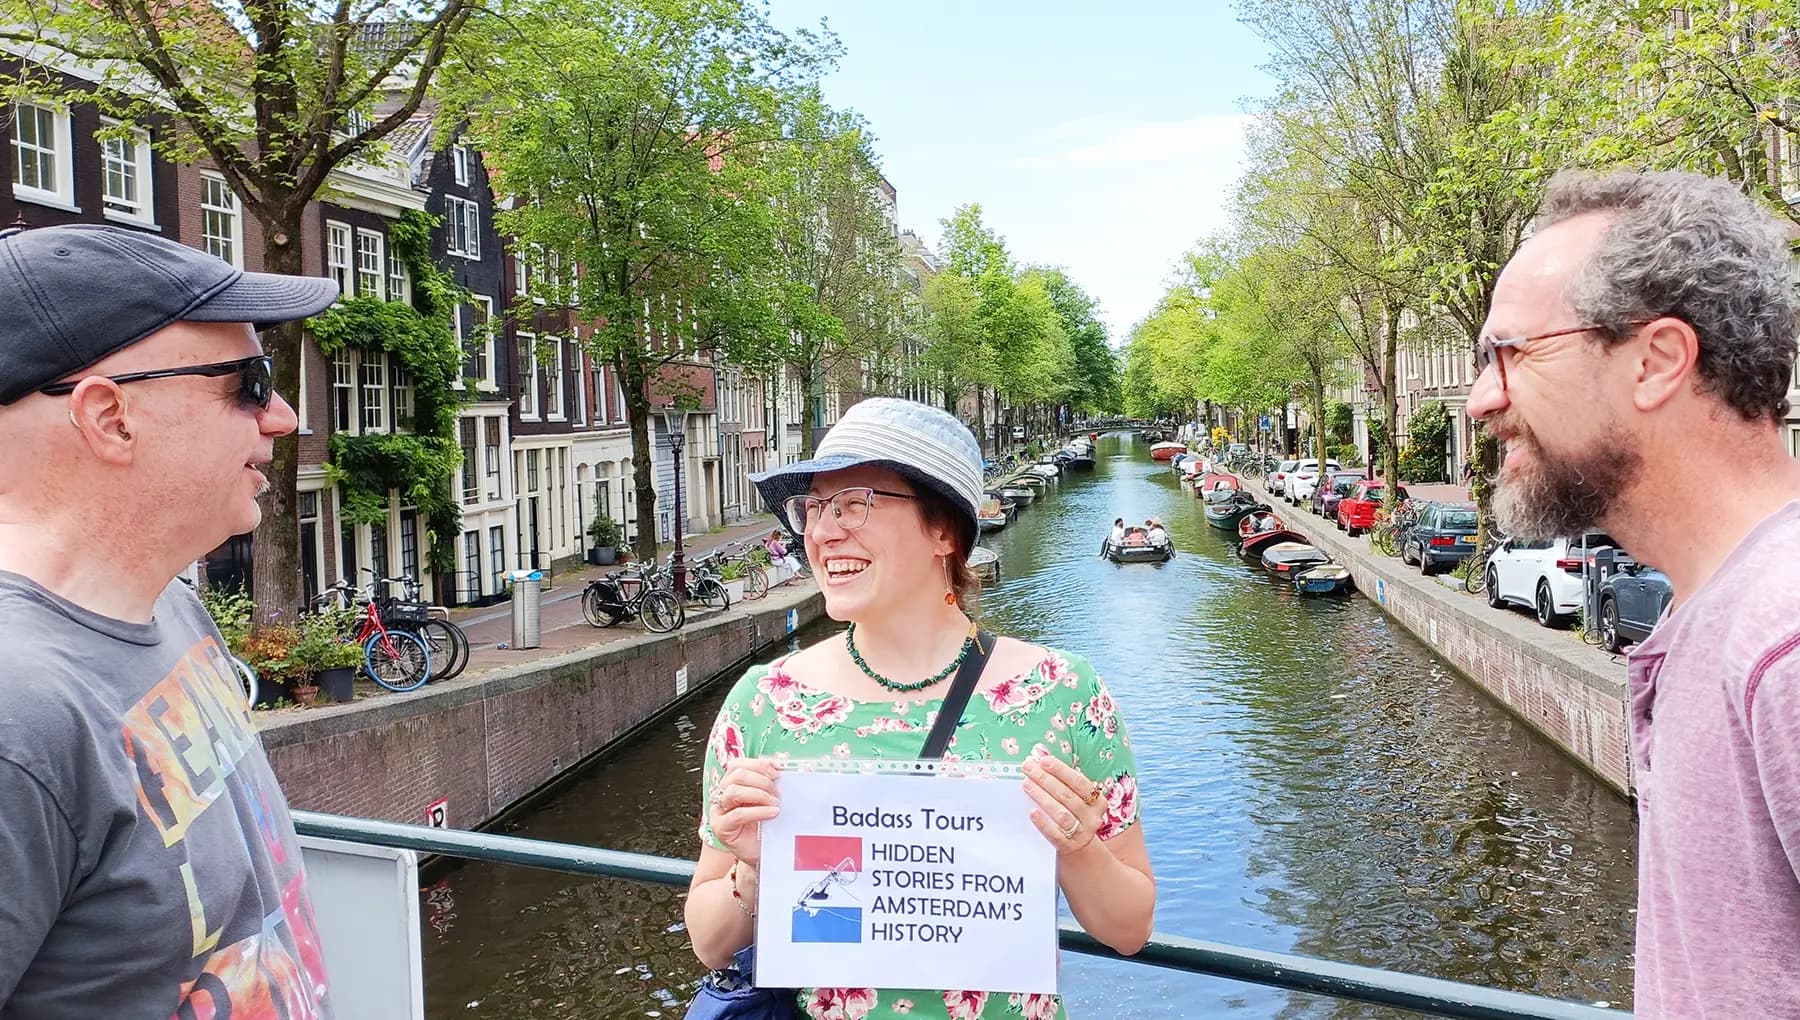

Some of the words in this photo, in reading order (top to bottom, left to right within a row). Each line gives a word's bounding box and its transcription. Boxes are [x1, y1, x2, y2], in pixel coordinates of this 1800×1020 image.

[832, 805, 913, 830] Badass
[920, 808, 985, 832] Tours
[871, 843, 955, 865] HIDDEN
[871, 869, 955, 891] STORIES
[962, 873, 1025, 895] FROM
[871, 896, 1024, 921] AMSTERDAM'S
[871, 922, 964, 944] HISTORY
